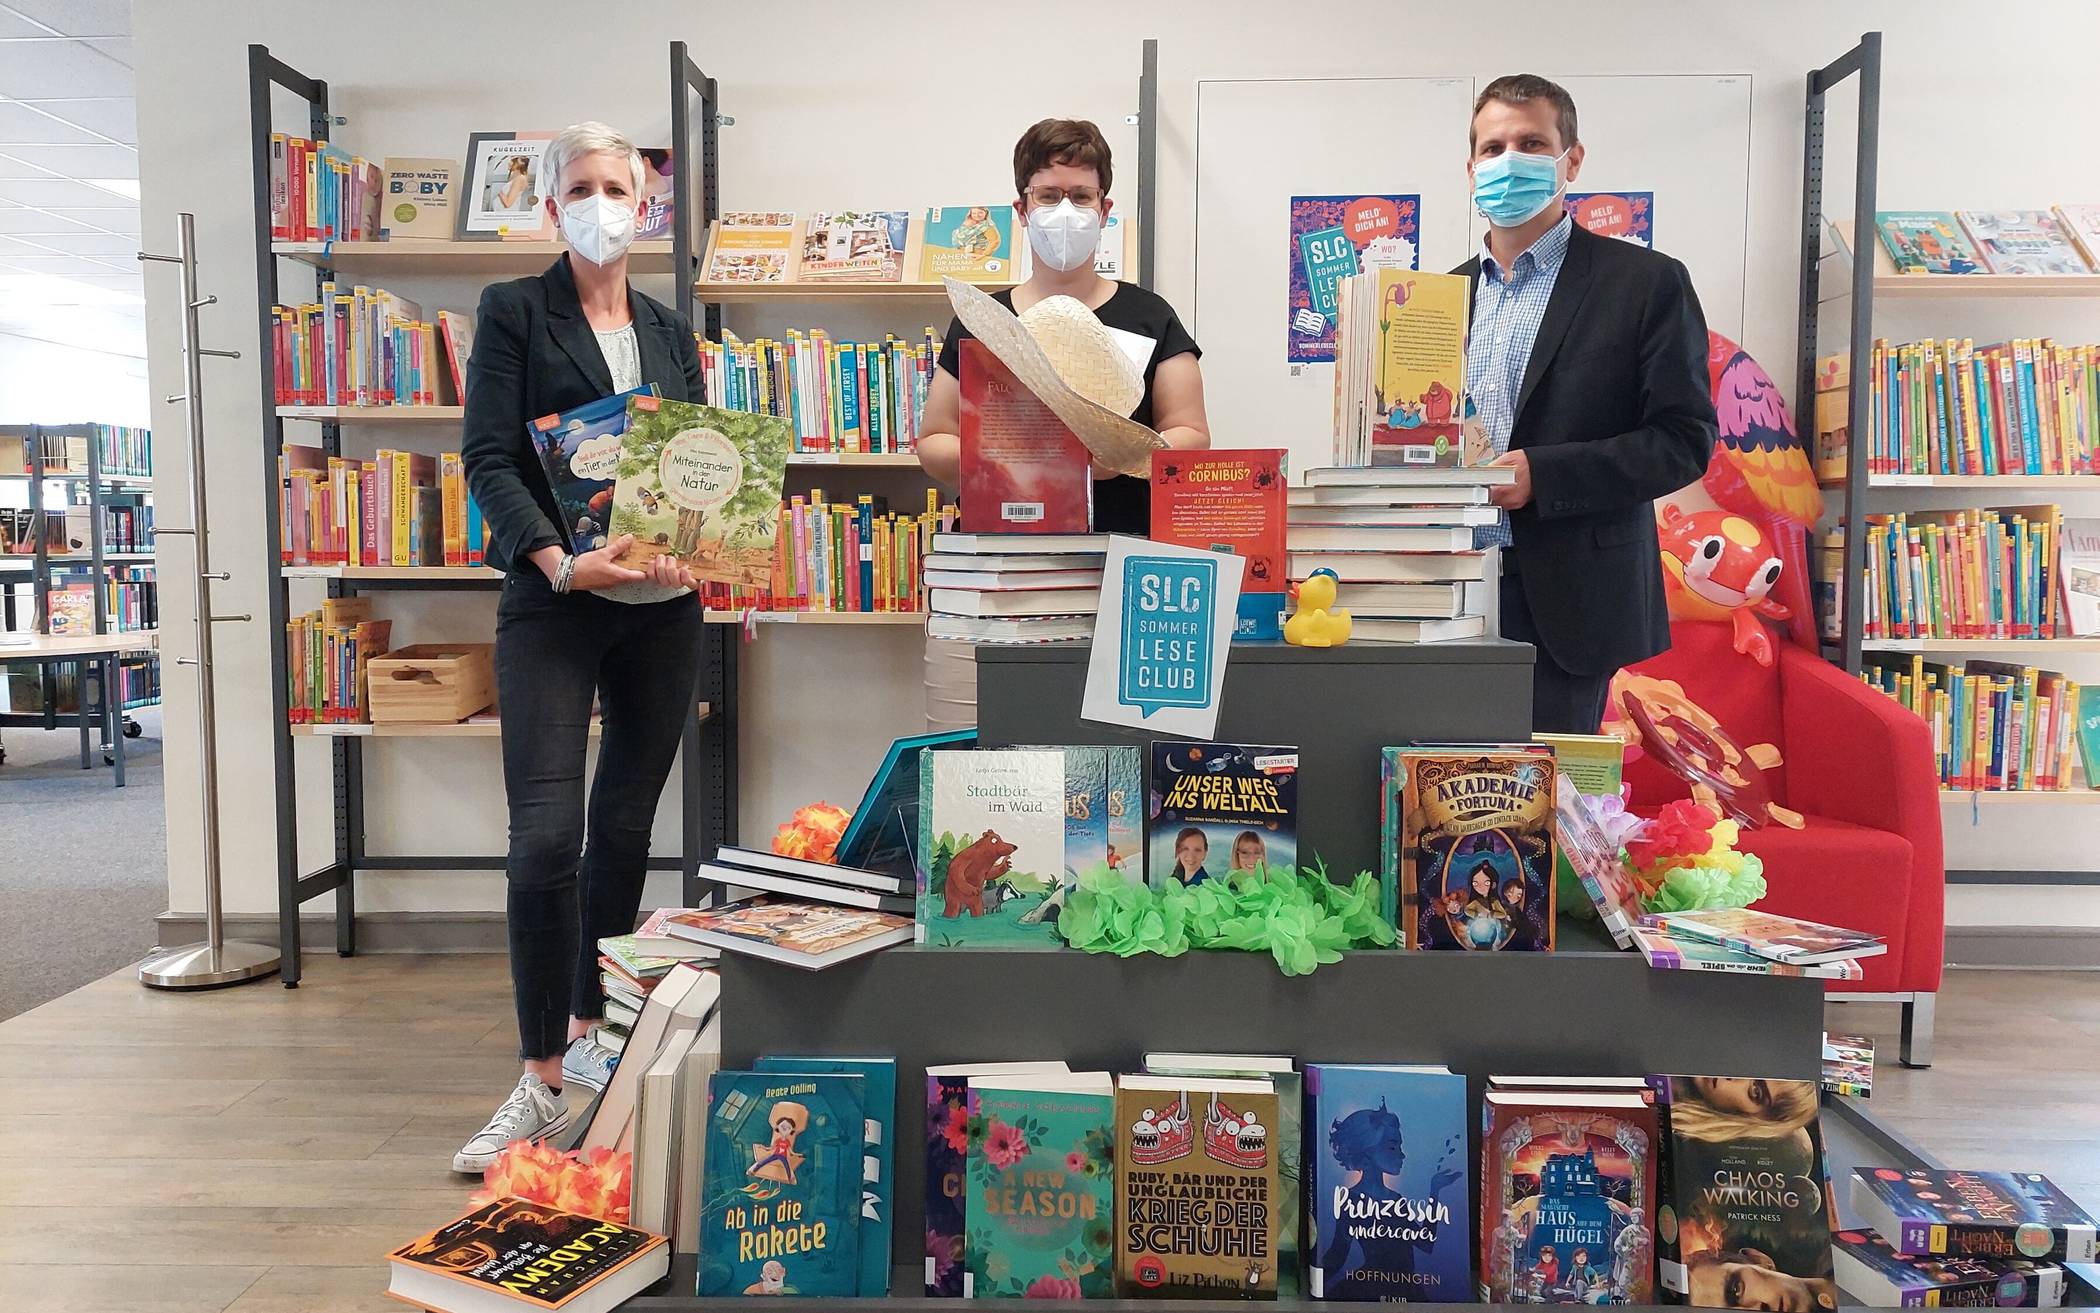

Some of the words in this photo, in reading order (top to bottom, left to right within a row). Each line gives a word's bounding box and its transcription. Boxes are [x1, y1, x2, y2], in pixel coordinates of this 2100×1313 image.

[493, 145, 535, 153] KUGELZEIT
[389, 172, 415, 180] ZERO
[417, 172, 449, 180] WASTE
[1354, 220, 1375, 233] DICH
[1375, 216, 1390, 230] AN!
[1309, 236, 1348, 264] SLC
[948, 259, 975, 267] MAMA
[1315, 262, 1351, 277] SOMMER
[842, 368, 851, 393] JERSEY
[843, 394, 852, 405] OF
[844, 405, 853, 421] BEST
[583, 460, 601, 473] Tier
[672, 454, 733, 473] Miteinander
[680, 474, 719, 492] Natur
[1188, 468, 1251, 482] CORNIBUS?
[365, 473, 375, 531] Geburtsbuch
[366, 532, 375, 548] Das
[393, 554, 408, 562] GU
[1140, 573, 1201, 613] SLC
[1139, 620, 1199, 635] SOMMER
[1139, 639, 1197, 662] LESE
[1138, 666, 1196, 690] CLUB
[966, 783, 1029, 798] Stadtbär
[1174, 774, 1233, 794] UNSER
[1236, 776, 1279, 797] WEG
[1437, 776, 1538, 802] AKADEMIE
[987, 801, 1006, 813] im
[1008, 800, 1044, 813] Wald
[1163, 791, 1199, 809] INS
[1202, 792, 1289, 814] WELTALL
[1457, 796, 1515, 812] FORTUNA
[1700, 961, 1726, 970] SPIEL
[765, 1086, 789, 1099] Beate
[790, 1082, 817, 1096] Dölling
[1003, 1169, 1017, 1187] A
[1022, 1171, 1065, 1190] NEW
[1128, 1171, 1169, 1186] RUBY,
[1172, 1170, 1201, 1186] BÄR
[1205, 1174, 1237, 1187] UND
[1239, 1175, 1268, 1188] DER
[1713, 1170, 1787, 1189] CHAOS
[1128, 1184, 1268, 1202] UNGLAUBLICHE
[1703, 1187, 1800, 1208] WALKING
[983, 1189, 1097, 1221] SEASON
[1127, 1197, 1212, 1227] KRIEG
[1216, 1199, 1269, 1229] DER
[1333, 1184, 1451, 1225] Prinzessin
[725, 1208, 746, 1231] Ab
[752, 1203, 769, 1227] in
[776, 1199, 802, 1222] die
[1535, 1210, 1577, 1226] HAUS
[1727, 1212, 1759, 1221] PATRICK
[1760, 1213, 1782, 1222] NESS
[1348, 1218, 1438, 1243] undercover
[1554, 1226, 1604, 1245] HÜGEL
[1950, 1229, 2005, 1244] NACHT
[535, 1243, 553, 1254] Die
[739, 1220, 827, 1264] Rakete
[1127, 1223, 1268, 1258] SCHUHE
[1960, 1242, 2014, 1257] ERBEN
[488, 1251, 536, 1281] Botschaft
[499, 1222, 624, 1294] ACADEMY
[470, 1258, 502, 1278] Wand
[1345, 1269, 1441, 1287] HOFFNUNGEN
